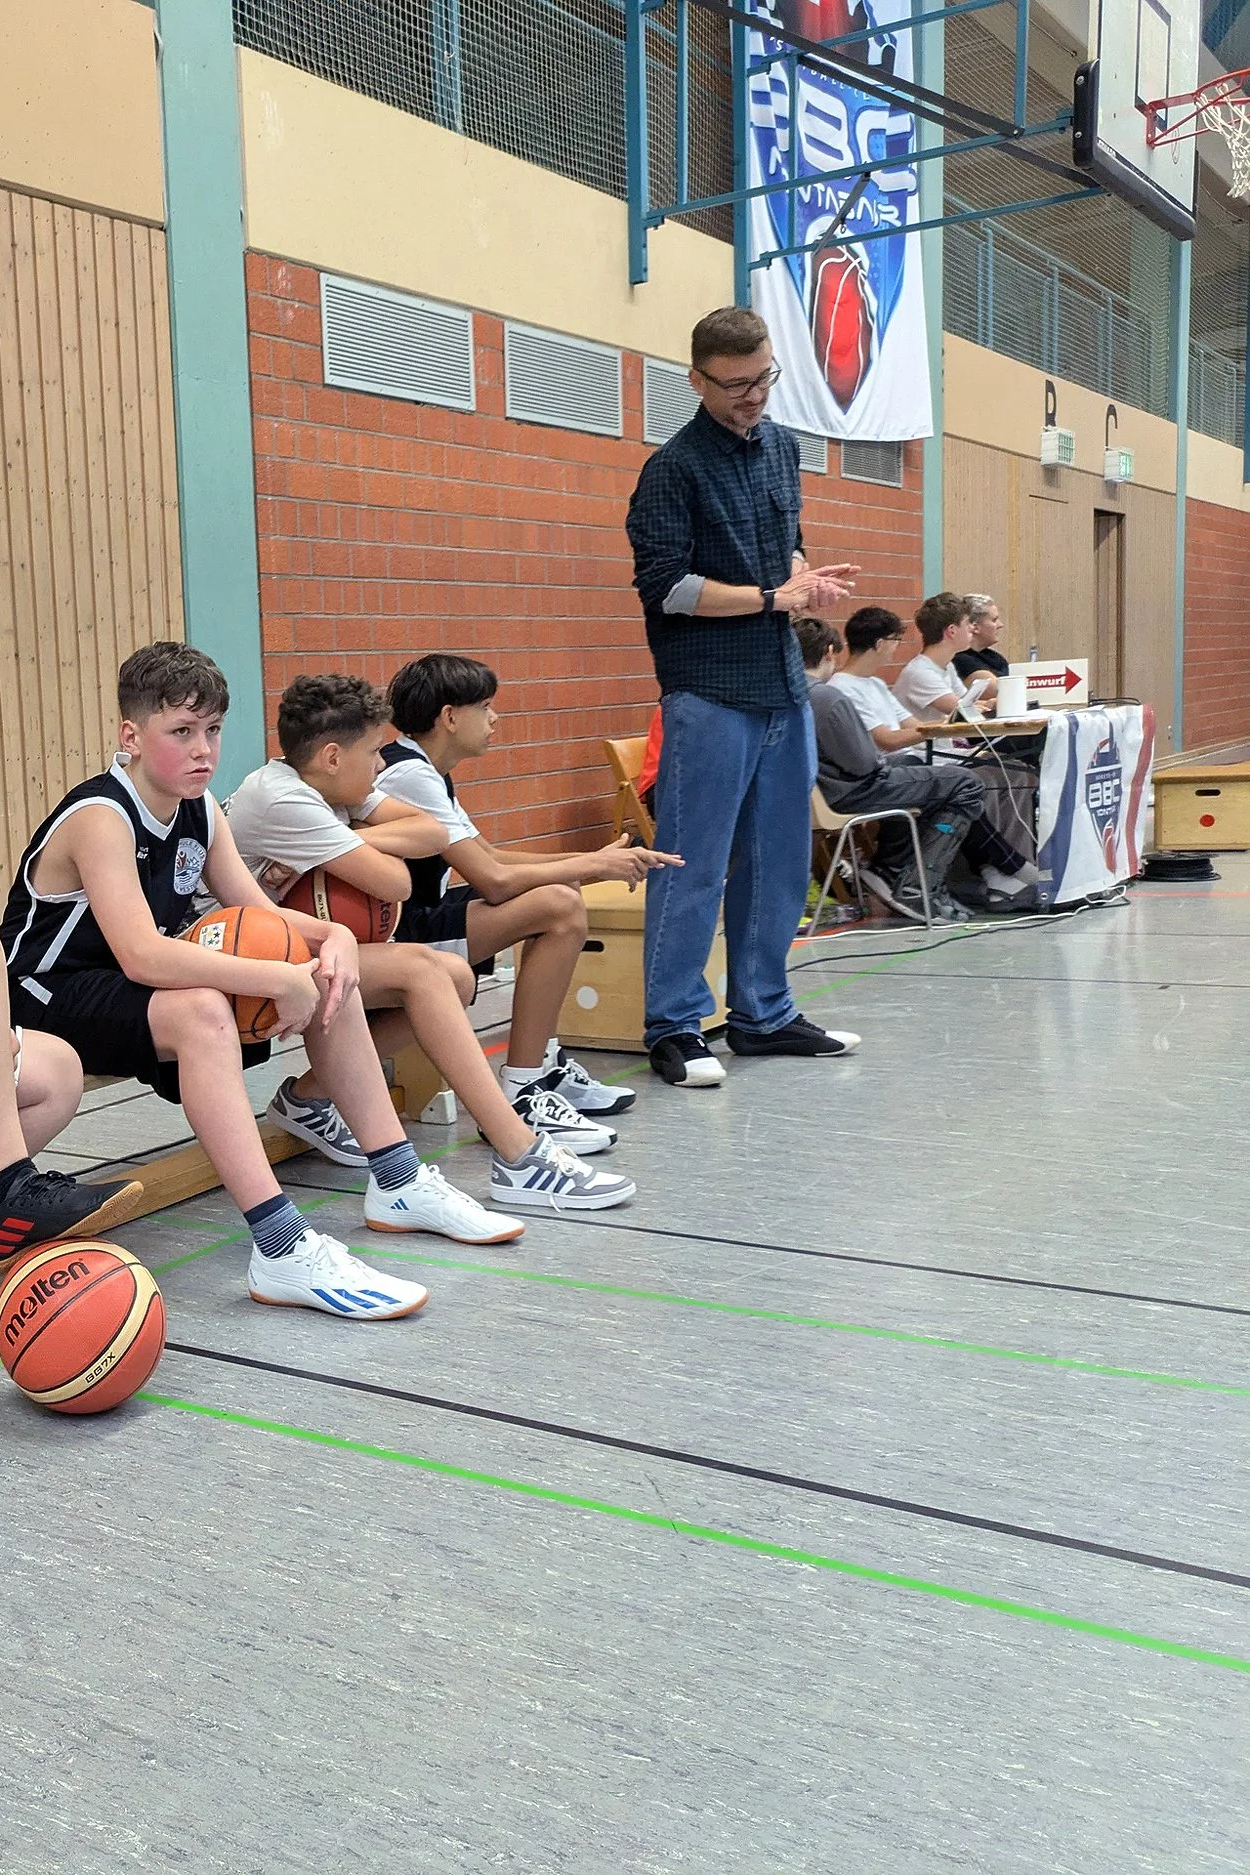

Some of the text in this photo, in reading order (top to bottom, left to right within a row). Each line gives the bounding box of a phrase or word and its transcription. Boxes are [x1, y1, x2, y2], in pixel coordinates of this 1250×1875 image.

[1025, 676, 1066, 687] inwurf
[1089, 779, 1120, 809] BBC
[4, 1258, 91, 1348] molten
